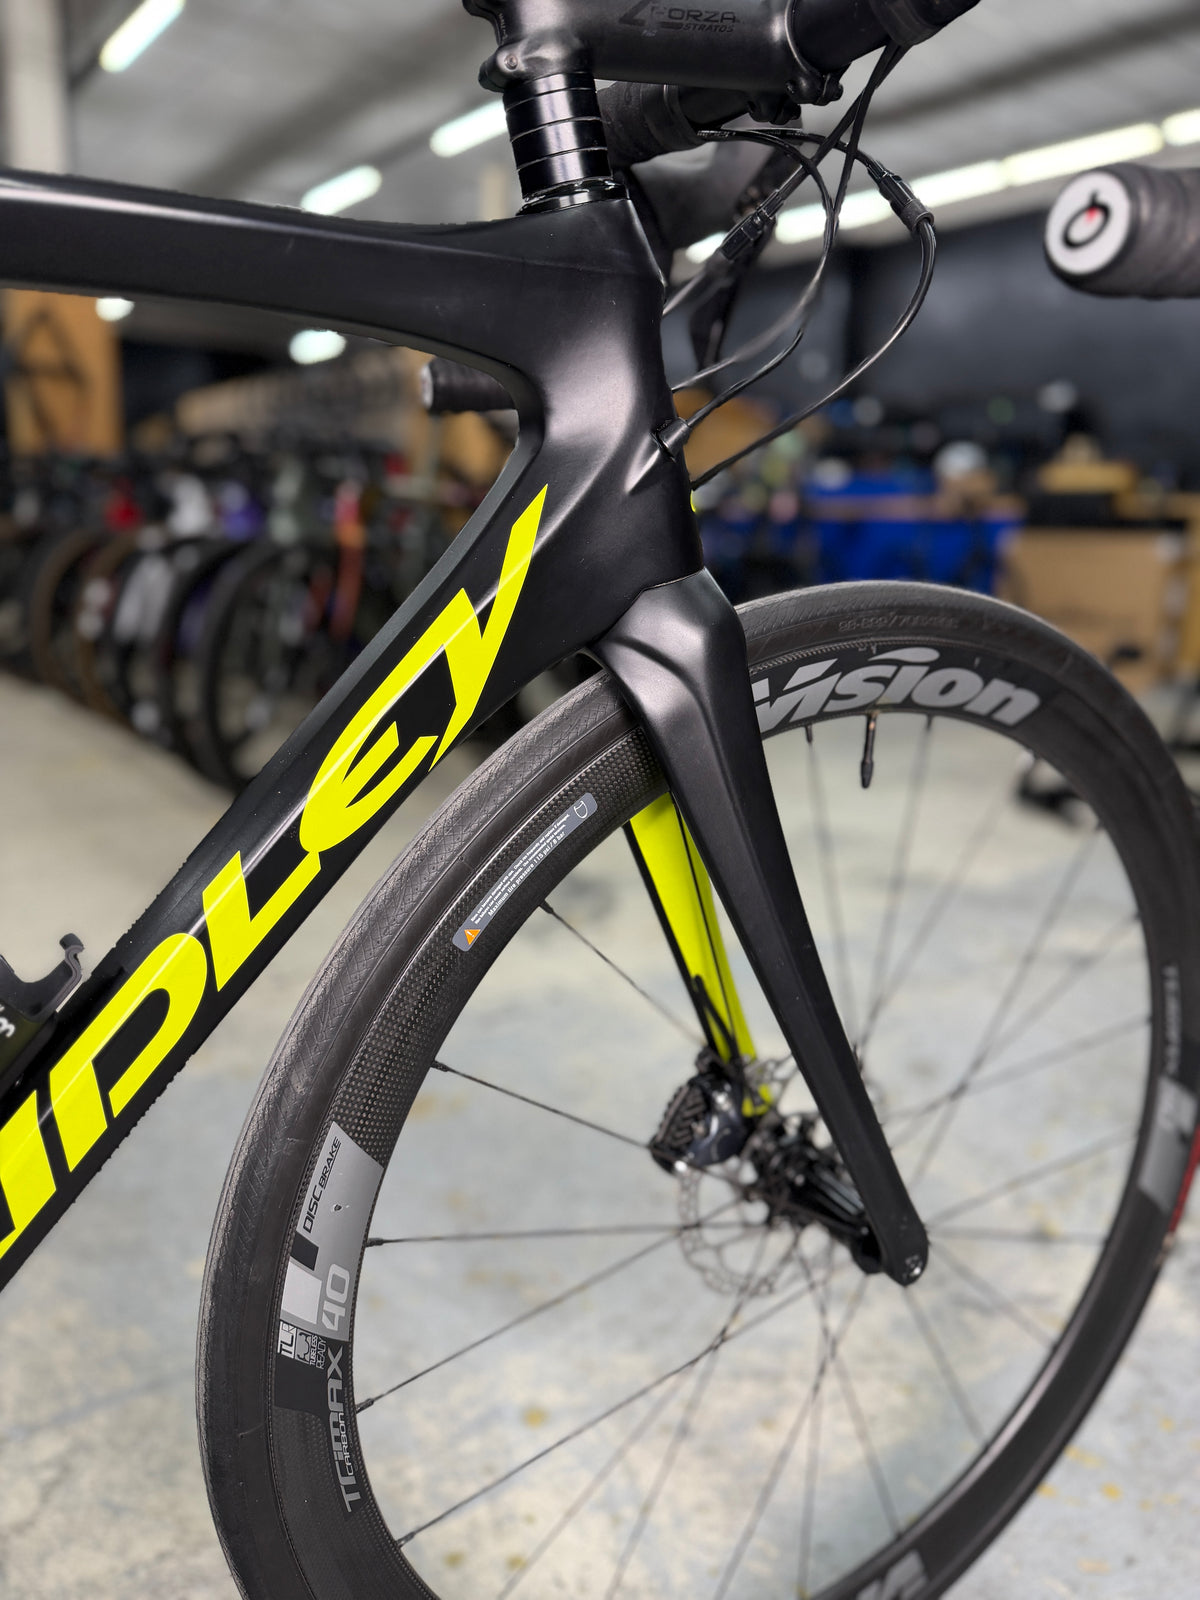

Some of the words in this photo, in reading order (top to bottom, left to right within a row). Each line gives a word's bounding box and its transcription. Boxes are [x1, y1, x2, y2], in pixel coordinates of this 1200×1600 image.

[682, 23, 734, 33] STRATOS
[751, 647, 1040, 733] Vision
[0, 484, 548, 1259] IDLEY
[488, 893, 508, 916] Maximum
[507, 883, 517, 893] tire
[515, 863, 535, 885] pressure
[533, 852, 544, 864] 115
[556, 831, 565, 841] bar
[303, 1184, 324, 1234] DISC
[318, 1136, 342, 1189] BRAKE
[321, 1263, 350, 1331] 40
[310, 1335, 318, 1366] TUBELESS
[316, 1337, 327, 1370] READY
